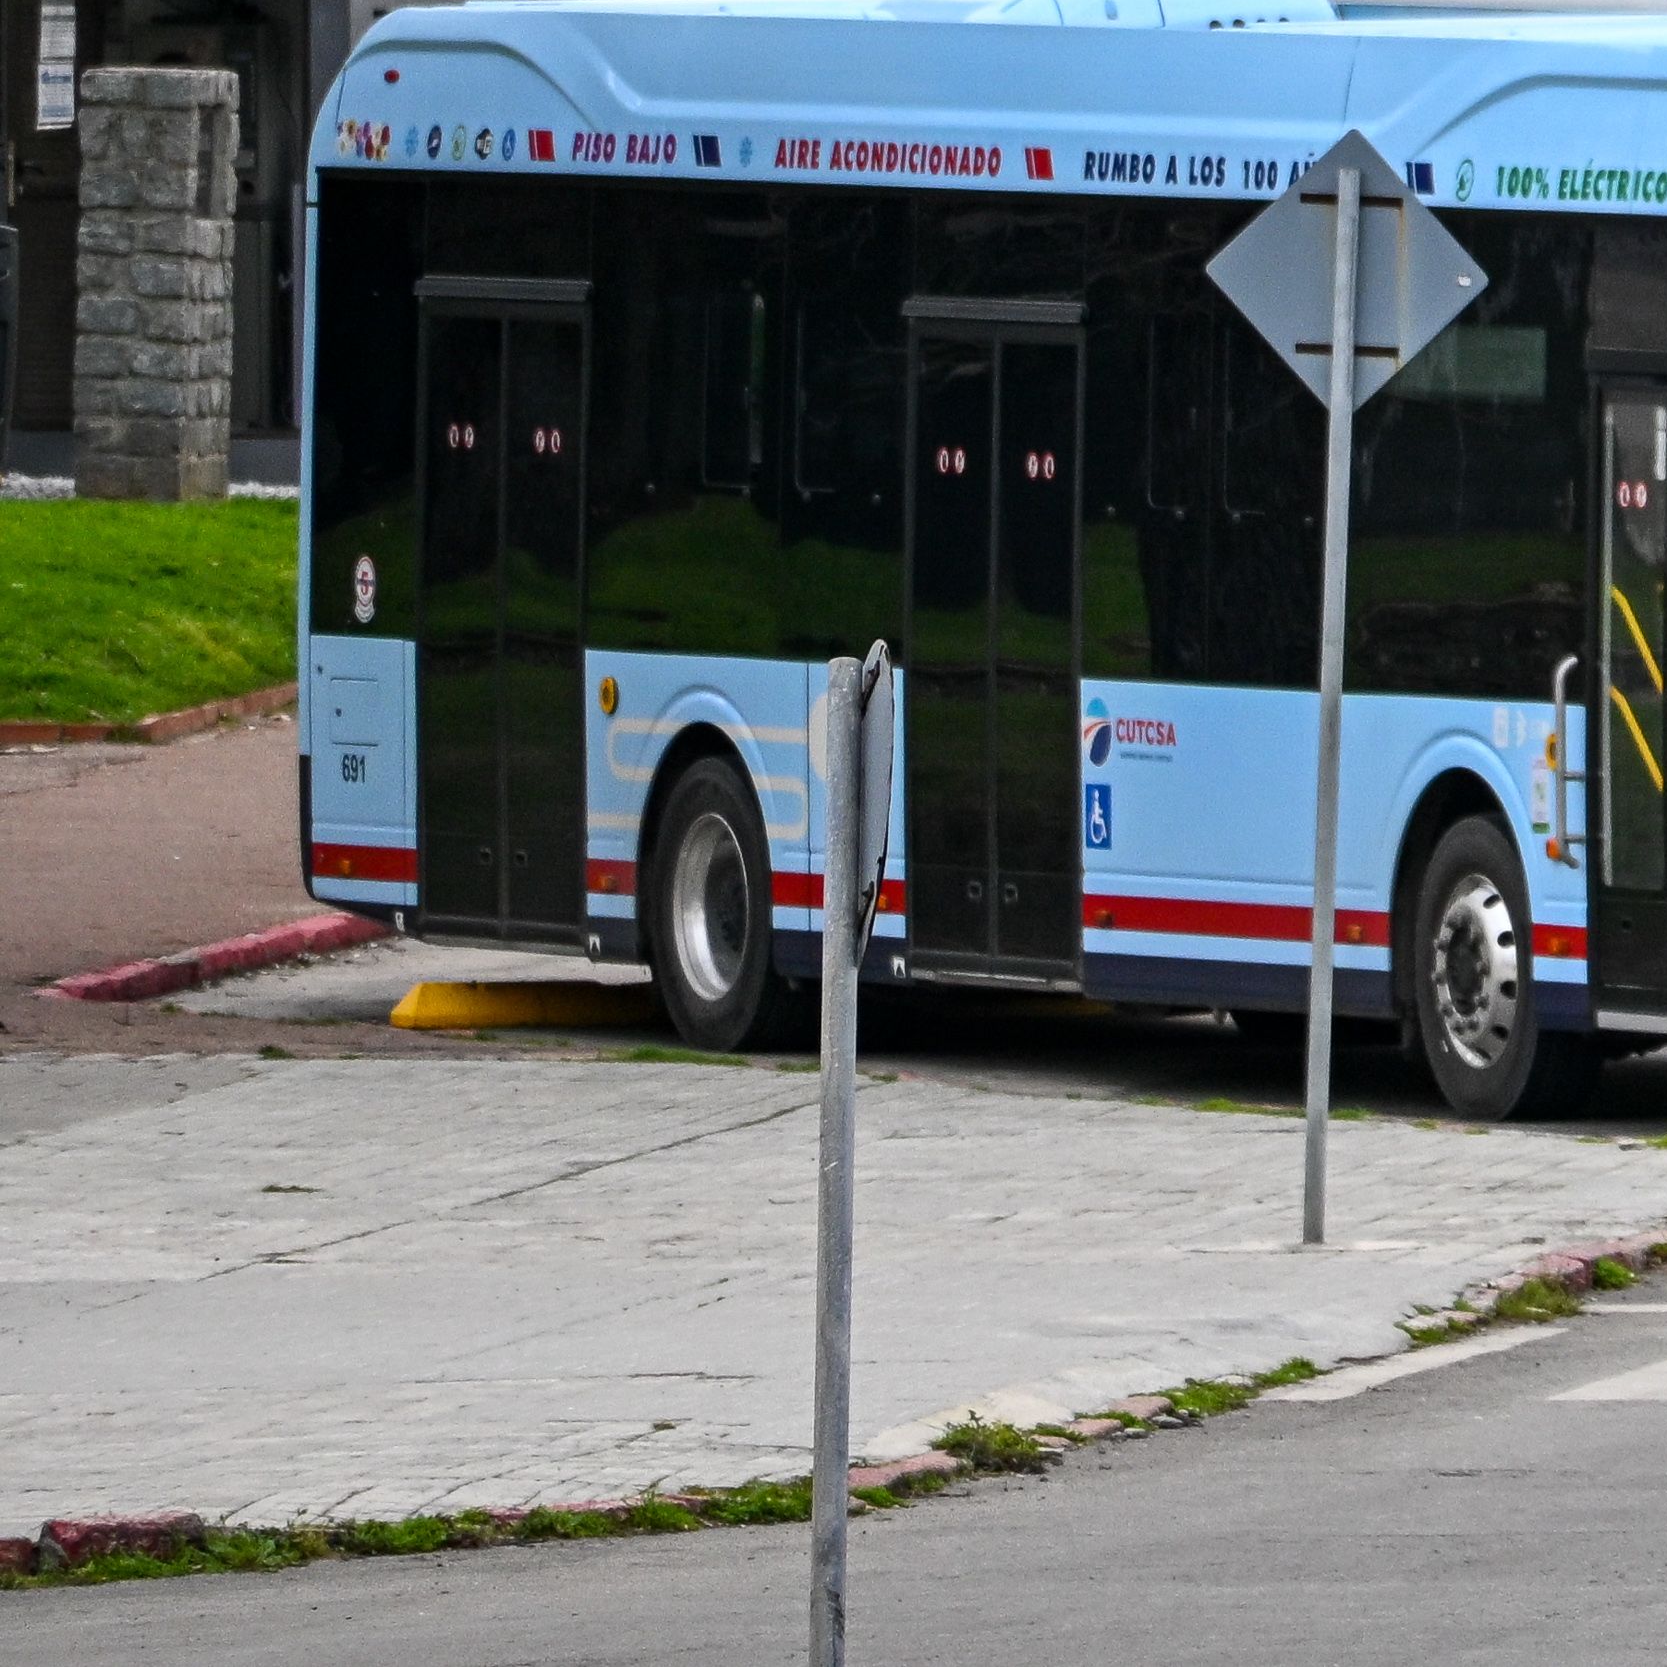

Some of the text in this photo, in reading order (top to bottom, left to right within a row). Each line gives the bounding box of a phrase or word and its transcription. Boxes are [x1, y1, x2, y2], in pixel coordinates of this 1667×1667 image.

[572, 131, 678, 164] PISO BAJO
[774, 137, 1002, 176] AIRE ACONDICIONADO
[1083, 151, 1155, 184] RUMBO
[1165, 154, 1179, 185] A
[1188, 155, 1226, 187] LOS
[1243, 160, 1278, 190] 100
[1497, 165, 1549, 200] 100%
[1116, 718, 1177, 746] CUTCSA
[341, 754, 366, 783] 691
